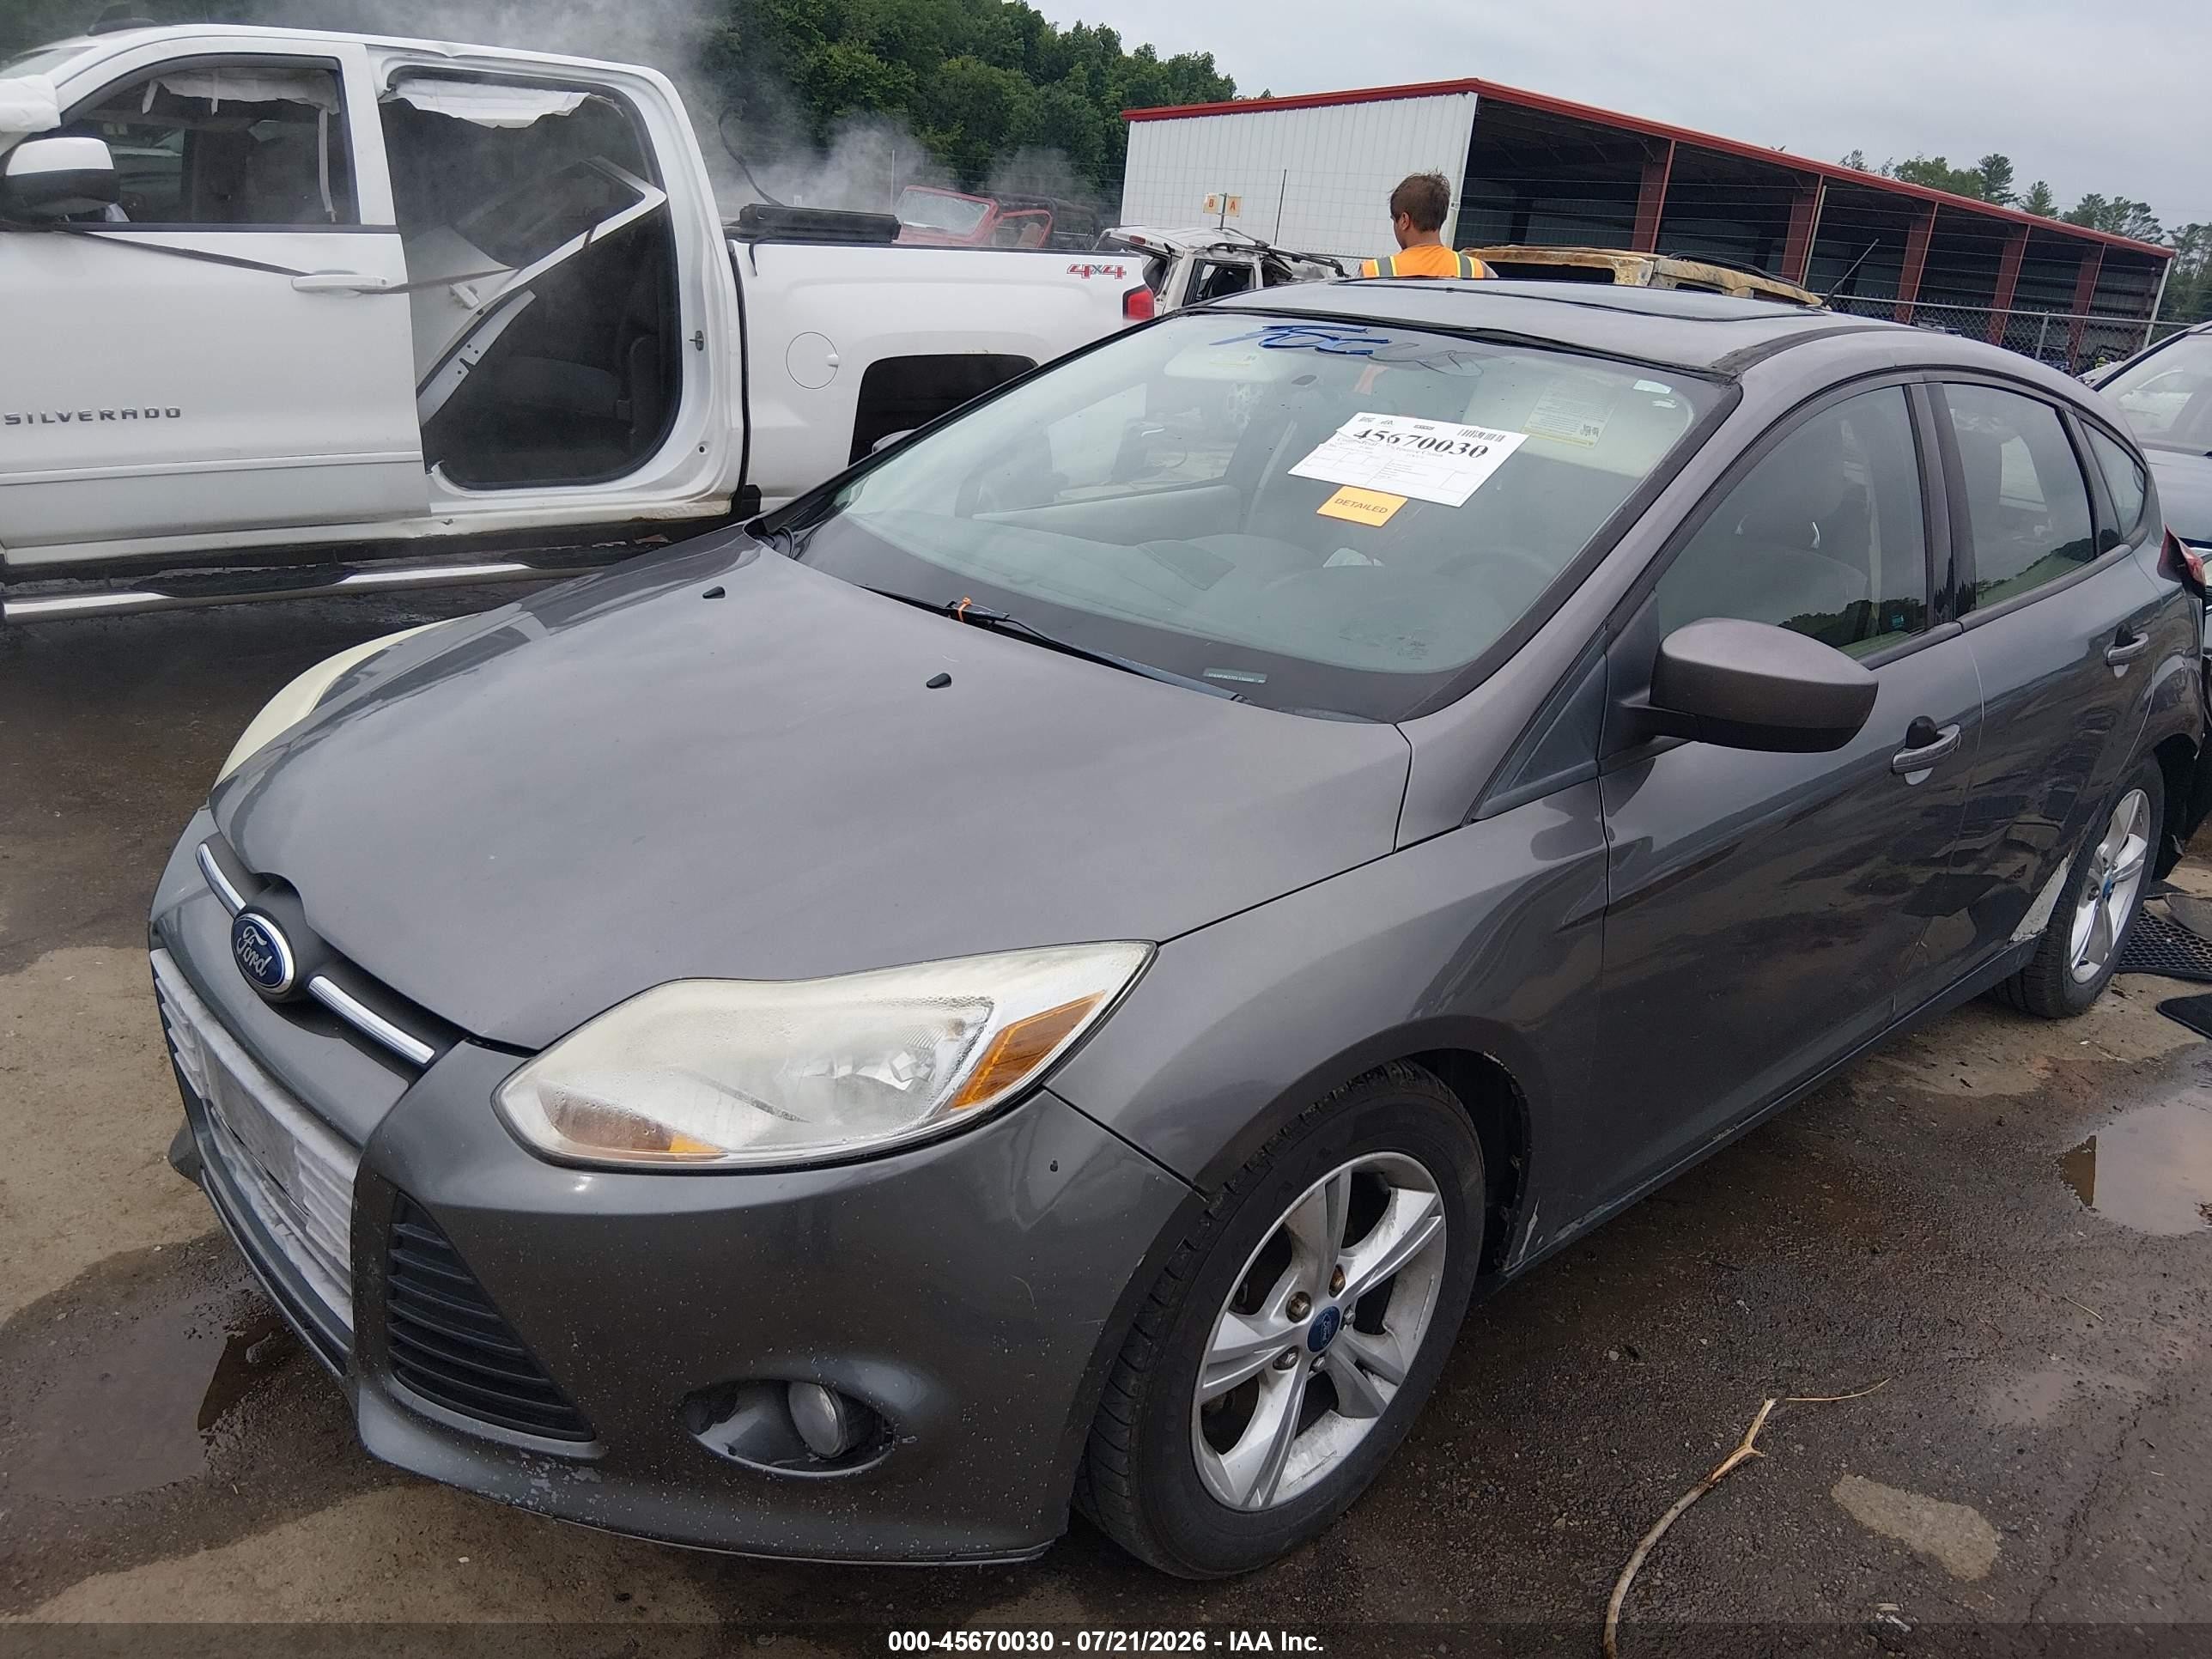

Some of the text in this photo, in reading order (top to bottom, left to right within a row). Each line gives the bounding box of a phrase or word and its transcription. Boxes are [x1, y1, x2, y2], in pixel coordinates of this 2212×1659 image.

[3, 406, 181, 426] SILVERADO
[1352, 428, 1489, 459] 45670030
[1334, 498, 1389, 514] DETAILED
[236, 926, 273, 977] Ford
